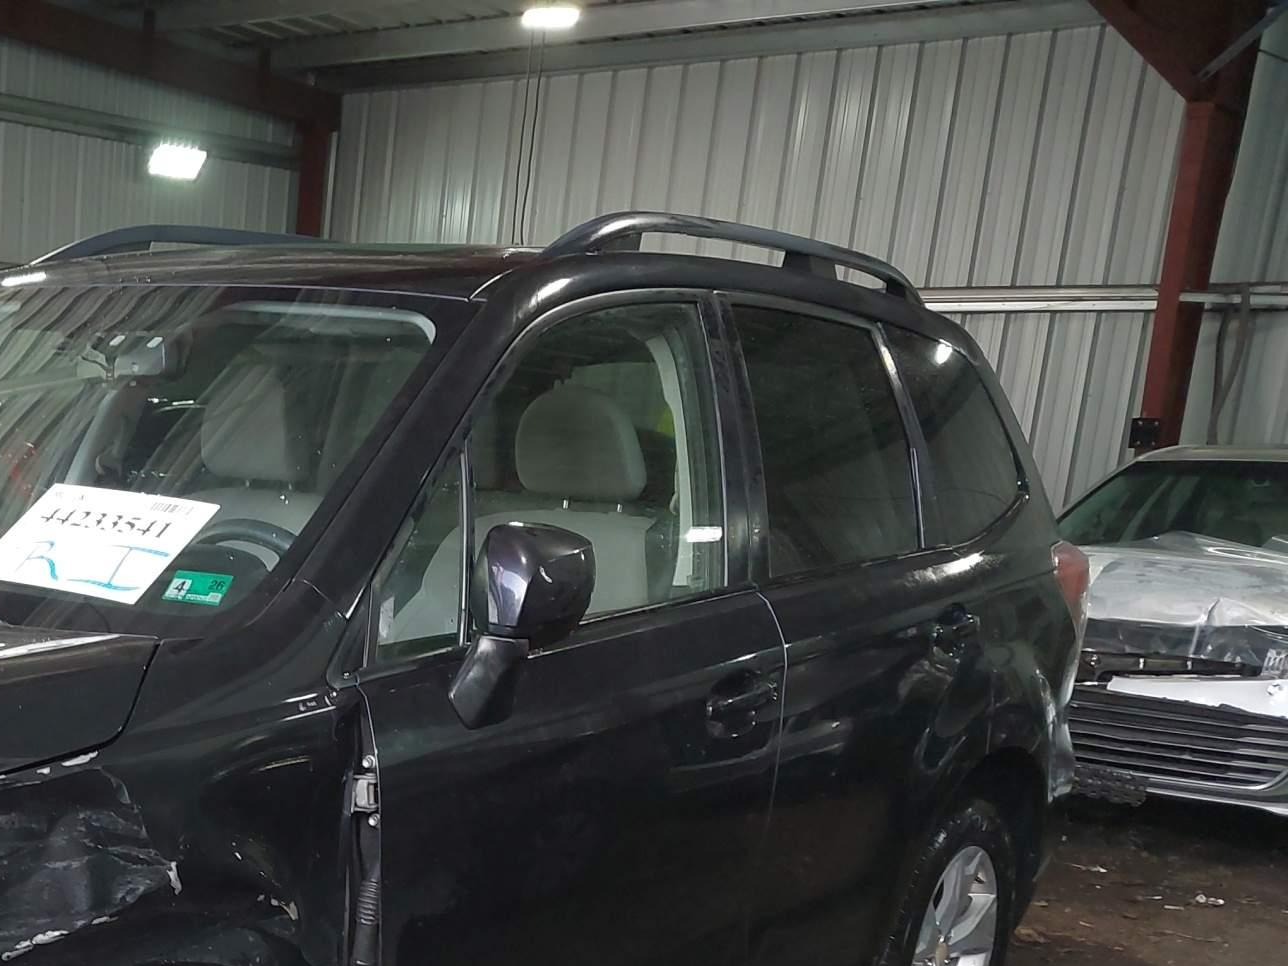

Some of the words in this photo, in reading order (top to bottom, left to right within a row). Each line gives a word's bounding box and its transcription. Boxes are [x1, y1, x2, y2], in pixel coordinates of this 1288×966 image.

[40, 507, 173, 538] 44233541
[173, 579, 187, 593] 4
[208, 579, 226, 592] 26
